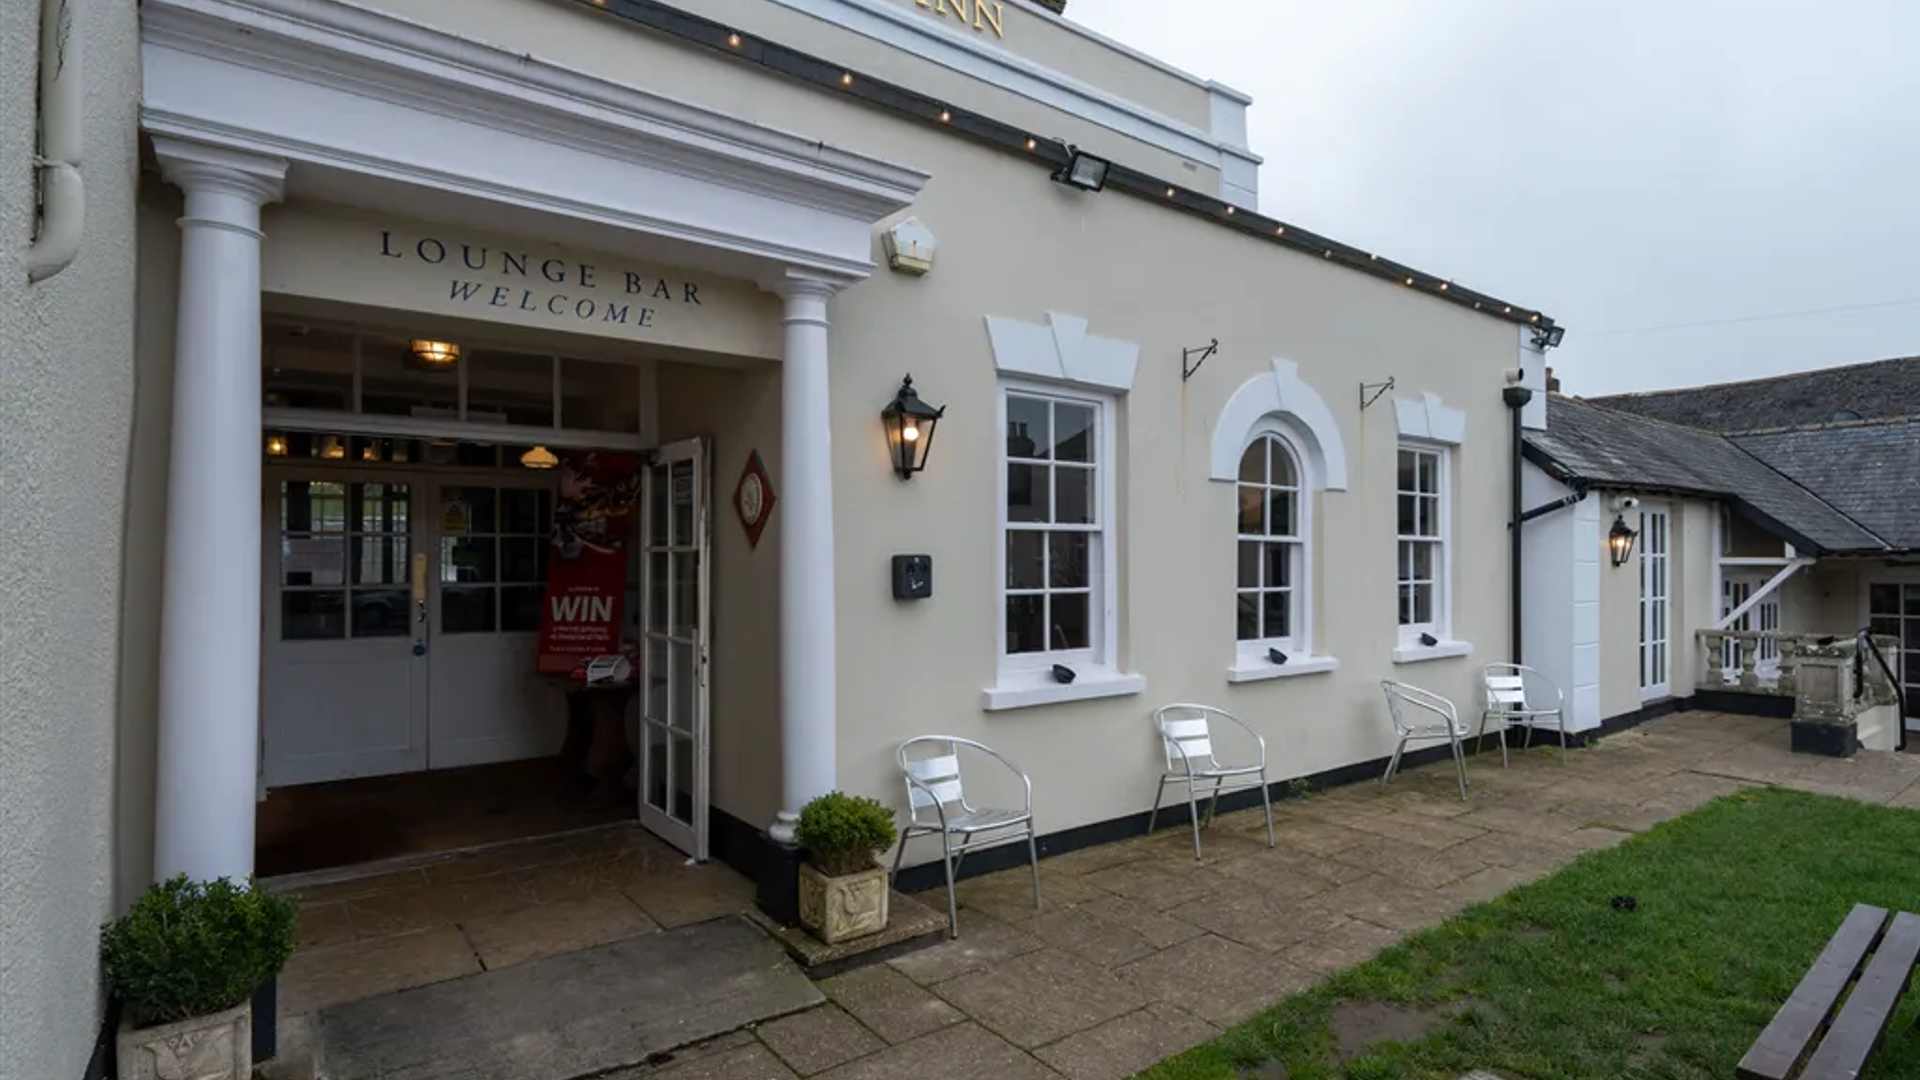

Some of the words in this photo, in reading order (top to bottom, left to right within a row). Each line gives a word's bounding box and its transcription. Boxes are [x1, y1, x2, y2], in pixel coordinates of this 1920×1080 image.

[915, 0, 1004, 38] NN
[380, 231, 597, 288] LOUNGE
[625, 271, 702, 305] BAR
[449, 280, 655, 328] WELCOME
[551, 596, 613, 622] WIN
